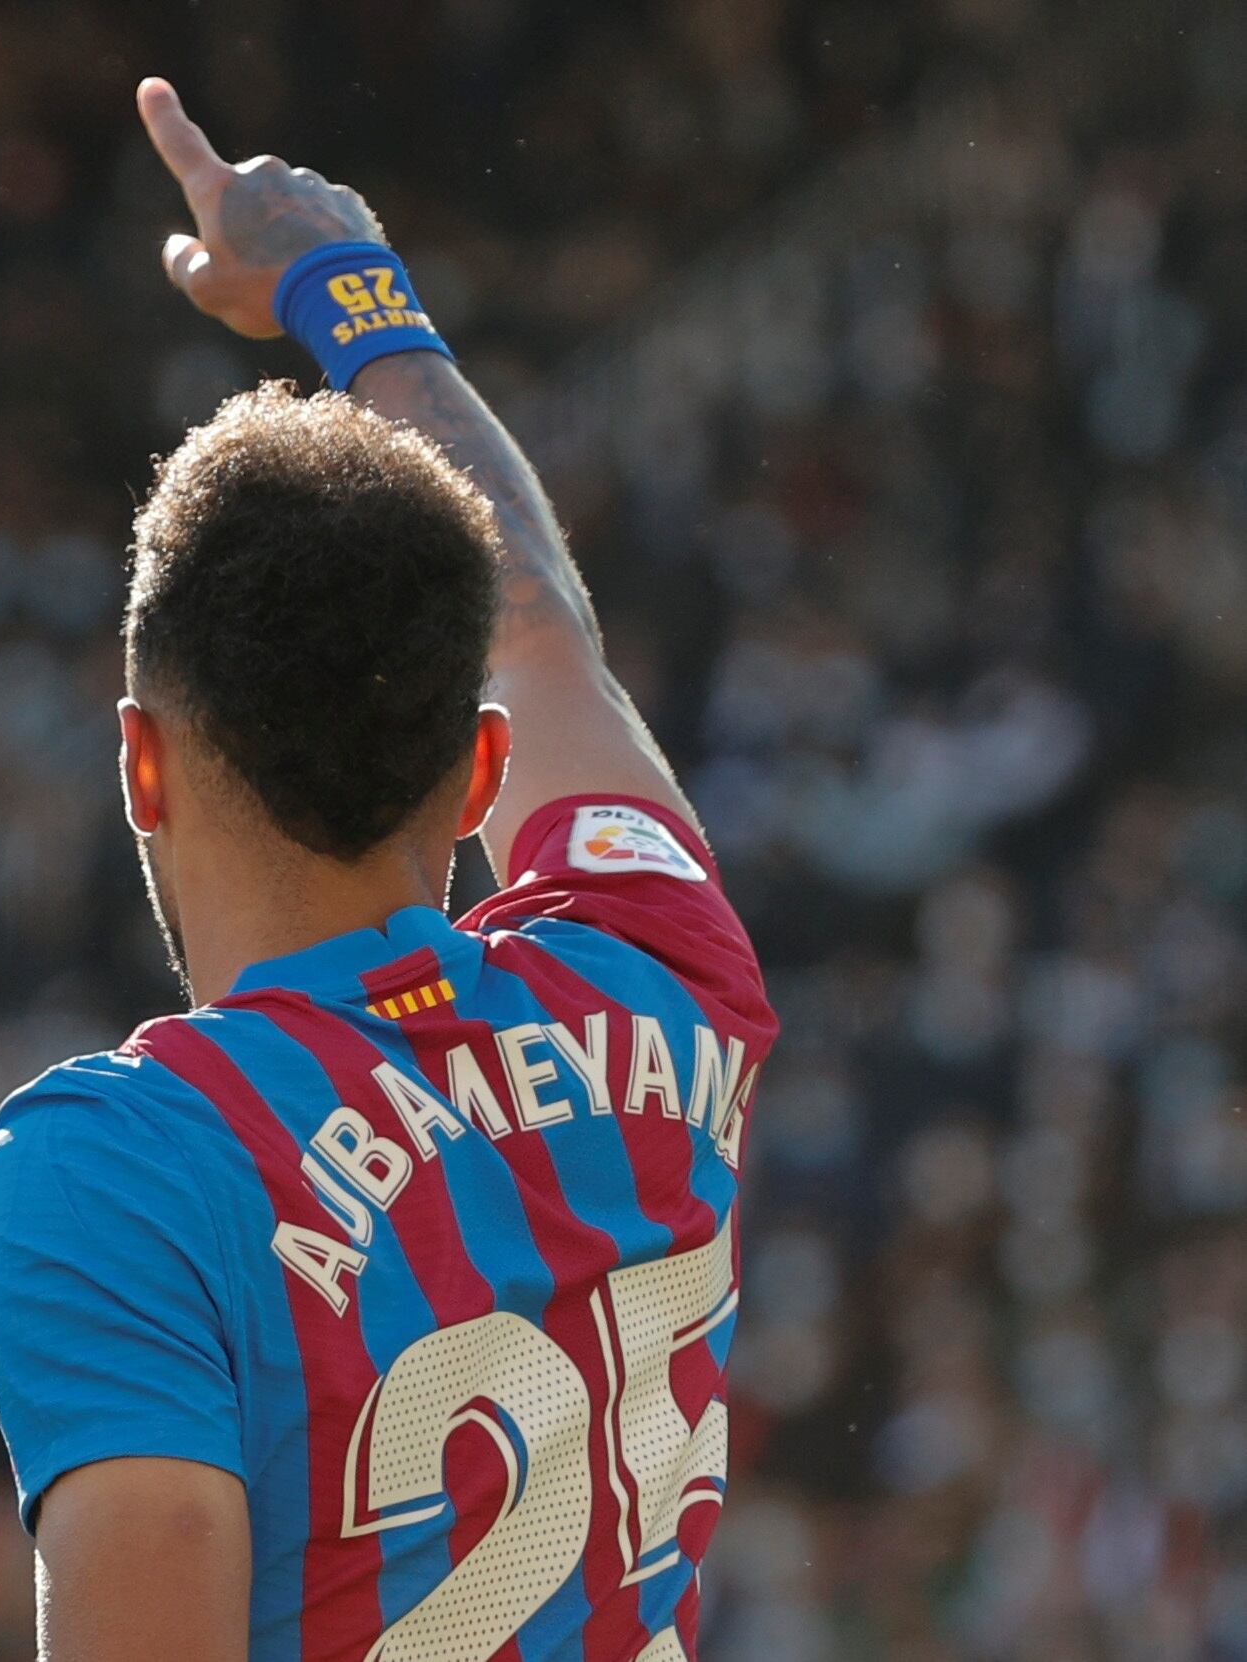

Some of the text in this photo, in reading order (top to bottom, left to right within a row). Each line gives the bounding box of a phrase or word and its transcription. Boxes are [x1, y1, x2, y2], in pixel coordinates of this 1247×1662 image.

[327, 267, 407, 316] 25
[271, 1010, 758, 1318] AUBAMEYANG
[340, 1206, 739, 1662] 25
